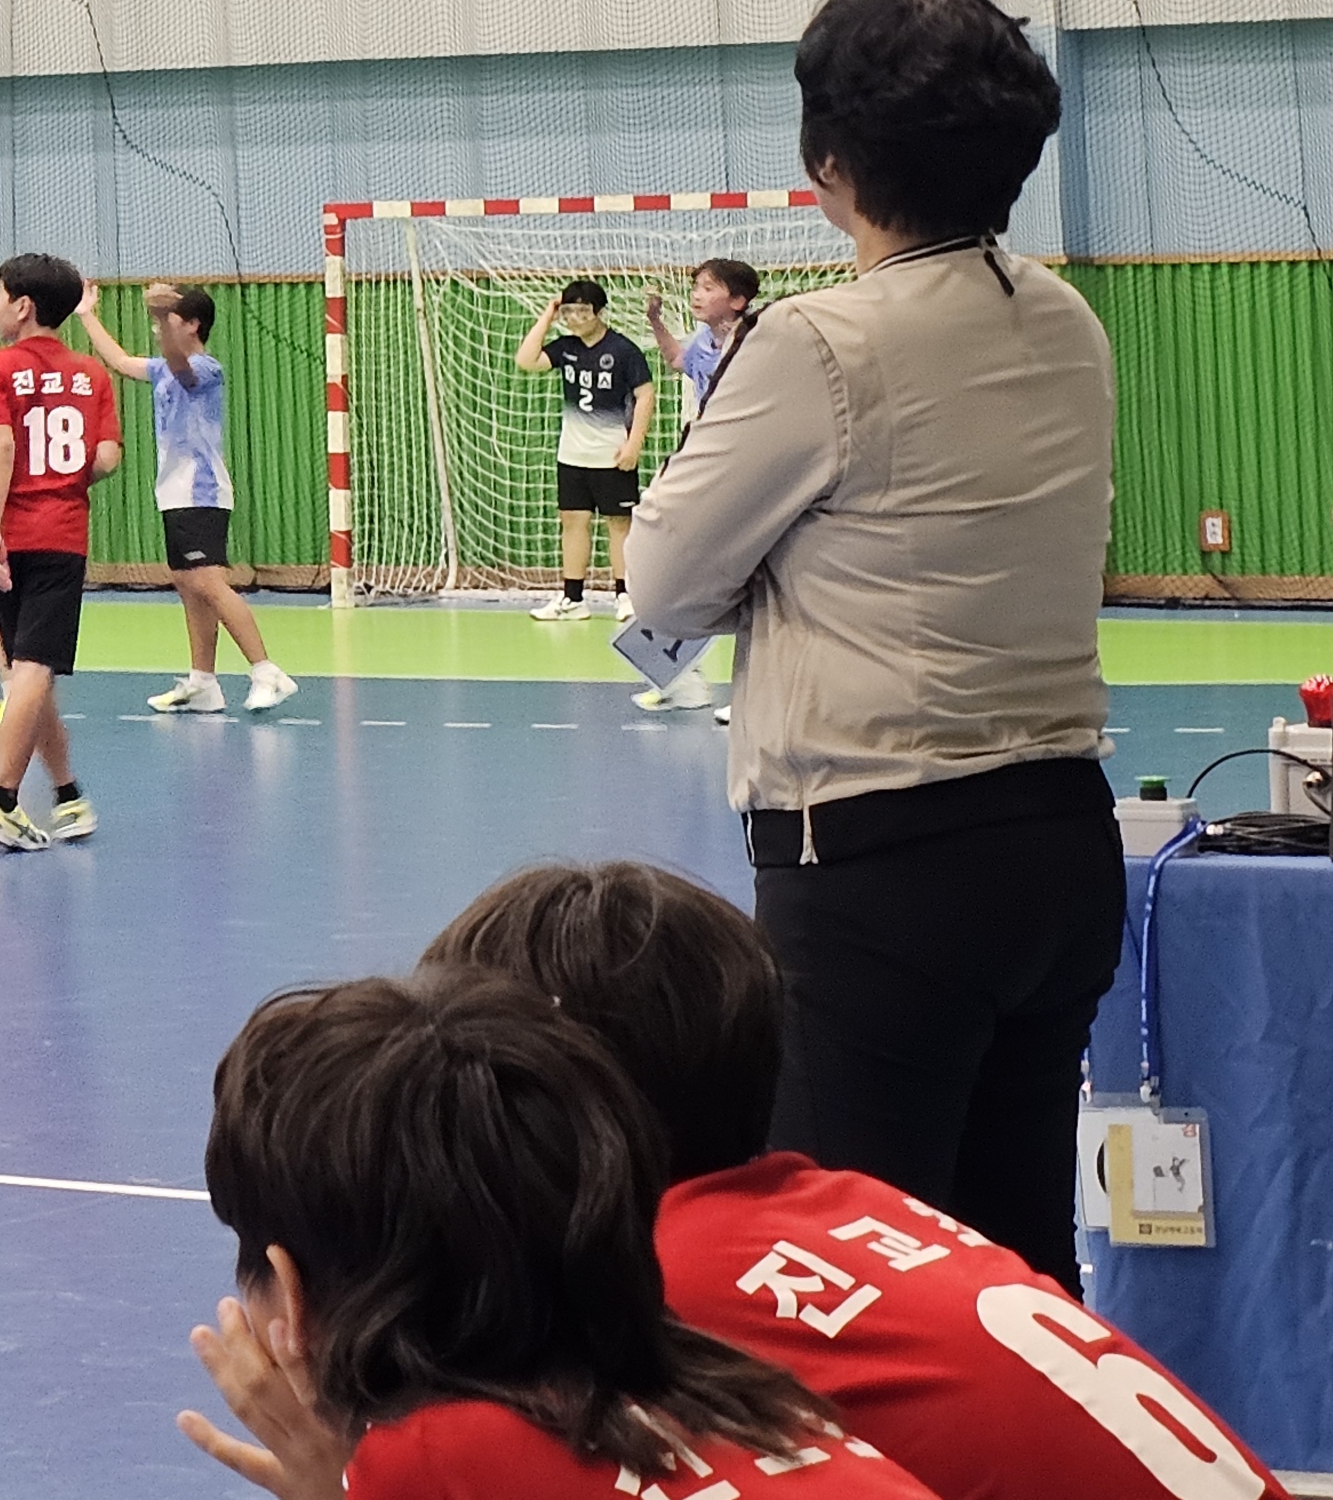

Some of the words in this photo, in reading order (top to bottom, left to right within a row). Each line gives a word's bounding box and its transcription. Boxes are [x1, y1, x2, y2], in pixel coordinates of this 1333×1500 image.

[12, 368, 93, 397] 진교초
[579, 388, 593, 412] 2
[23, 405, 87, 476] 18
[976, 1283, 1267, 1500] 6
